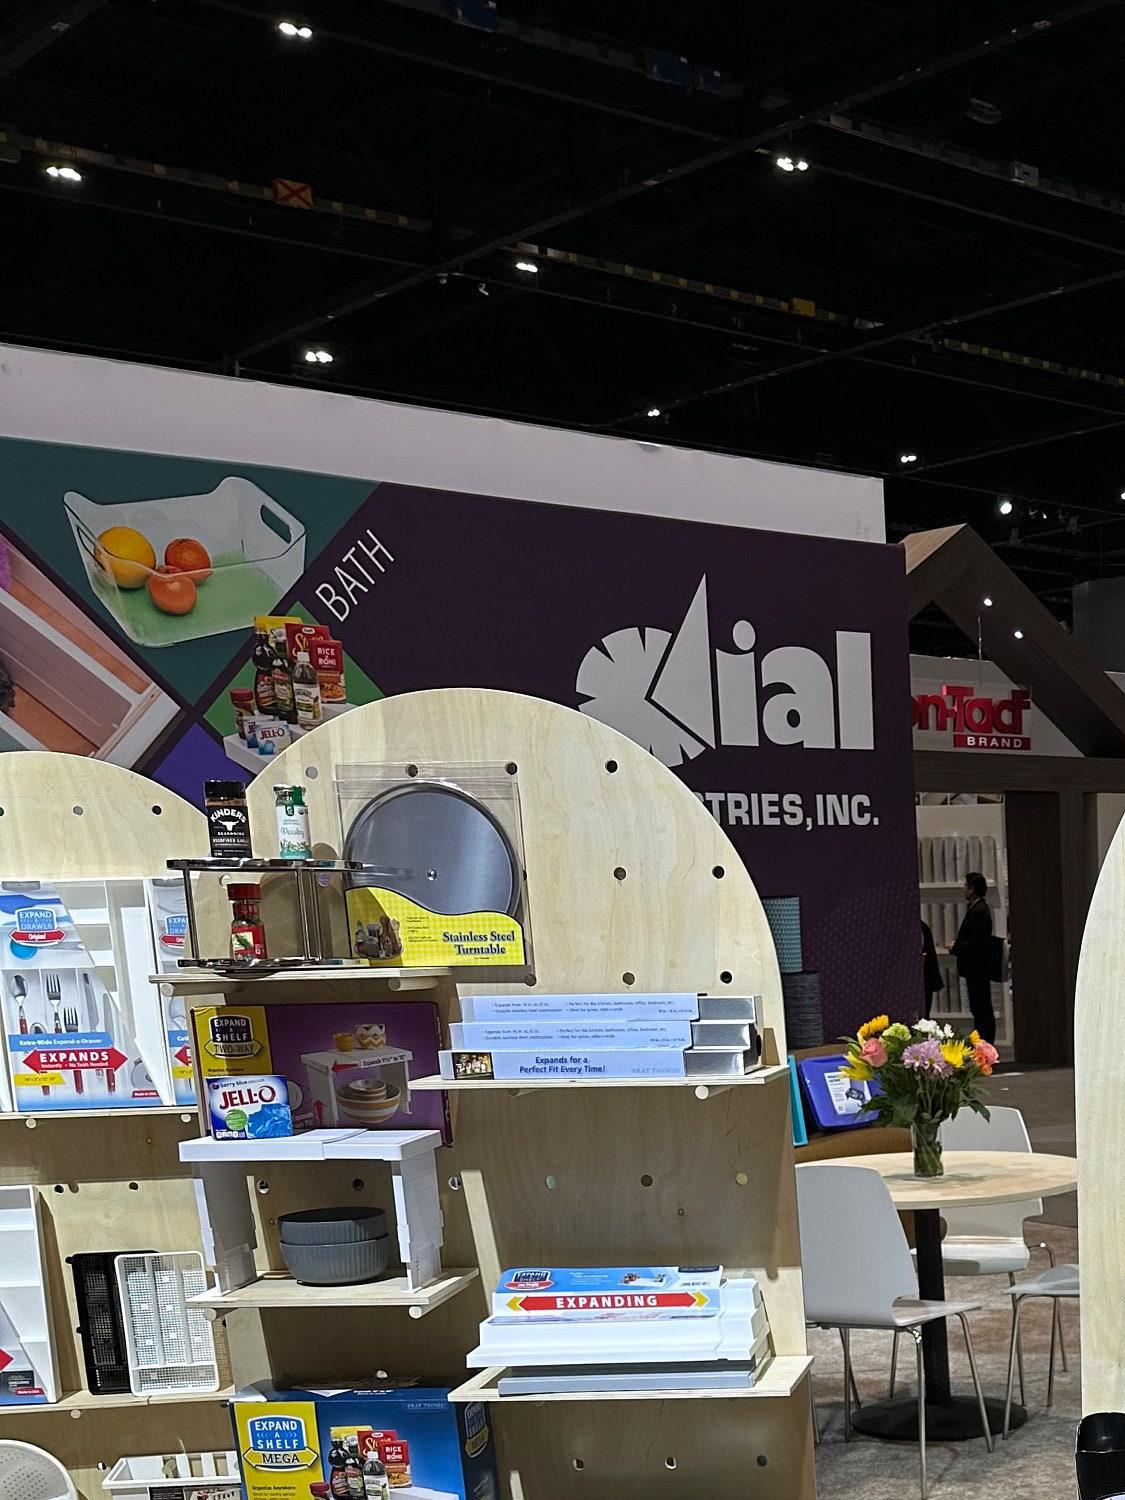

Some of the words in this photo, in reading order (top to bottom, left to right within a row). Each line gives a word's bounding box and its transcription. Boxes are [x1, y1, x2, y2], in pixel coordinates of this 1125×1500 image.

[315, 530, 394, 621] BATH
[967, 737, 1022, 747] BRAND
[20, 911, 52, 919] EXPAND
[442, 931, 488, 942] Stainless
[490, 930, 515, 941] Steel
[454, 944, 506, 955] Turntable
[214, 1018, 246, 1028] EXPAND
[216, 1033, 247, 1042] SHELF
[39, 1051, 109, 1063] EXPANDS
[535, 1056, 567, 1065] Expands
[570, 1055, 582, 1064] for
[519, 1064, 546, 1074] Perfect
[549, 1064, 558, 1073] Fit
[560, 1065, 582, 1075] Every
[584, 1065, 606, 1073] Time!
[556, 1296, 658, 1309] EXPANDING
[255, 1421, 298, 1431] EXPAND
[257, 1439, 299, 1450] SHELF
[262, 1453, 300, 1464] MEGA
